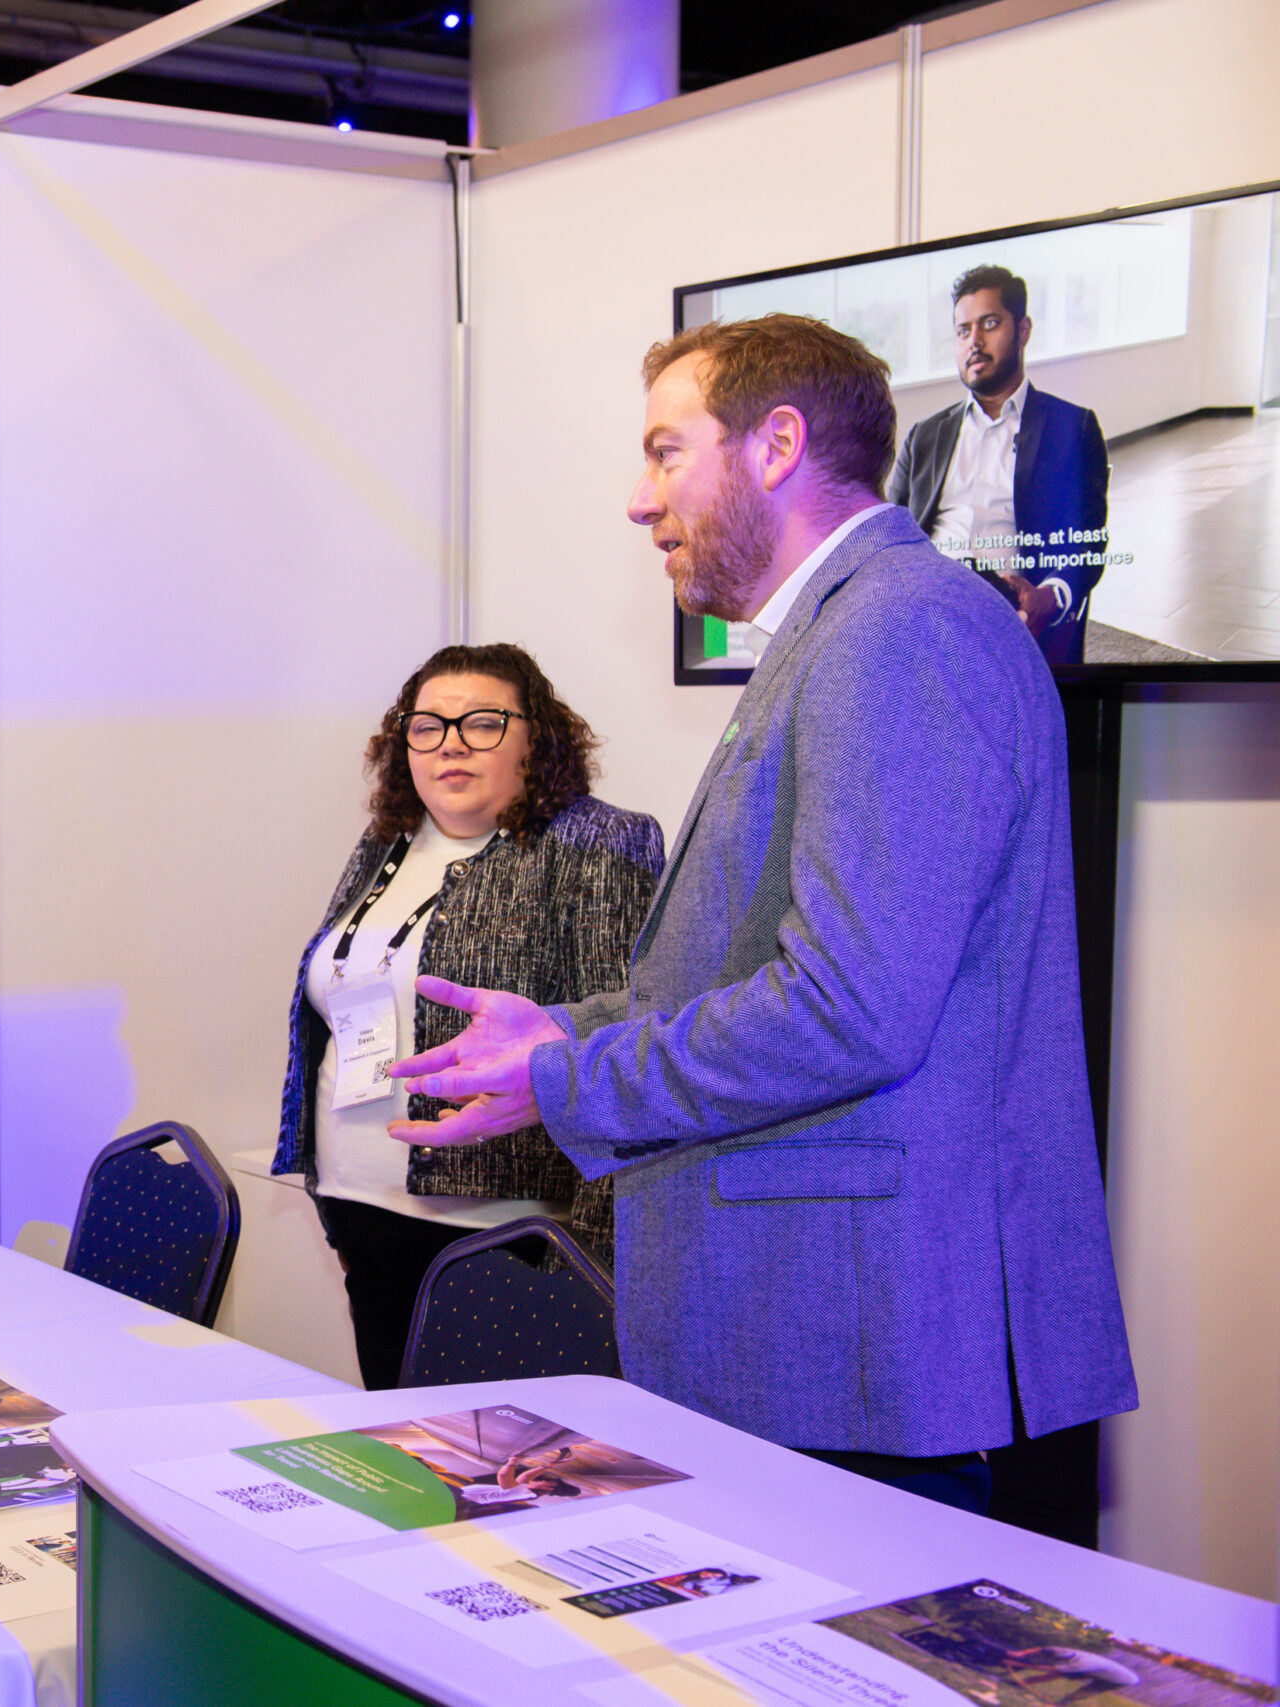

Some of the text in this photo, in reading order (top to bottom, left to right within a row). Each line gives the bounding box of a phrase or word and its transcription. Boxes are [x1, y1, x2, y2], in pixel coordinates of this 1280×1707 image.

[974, 530, 1045, 550] batteries,
[1049, 529, 1065, 545] at
[1068, 526, 1109, 544] least
[976, 555, 1007, 572] that
[1010, 552, 1035, 570] the
[1039, 550, 1134, 571] importance
[759, 1642, 789, 1658] the
[790, 1659, 845, 1685] Silent
[778, 1637, 909, 1700] Understanding
